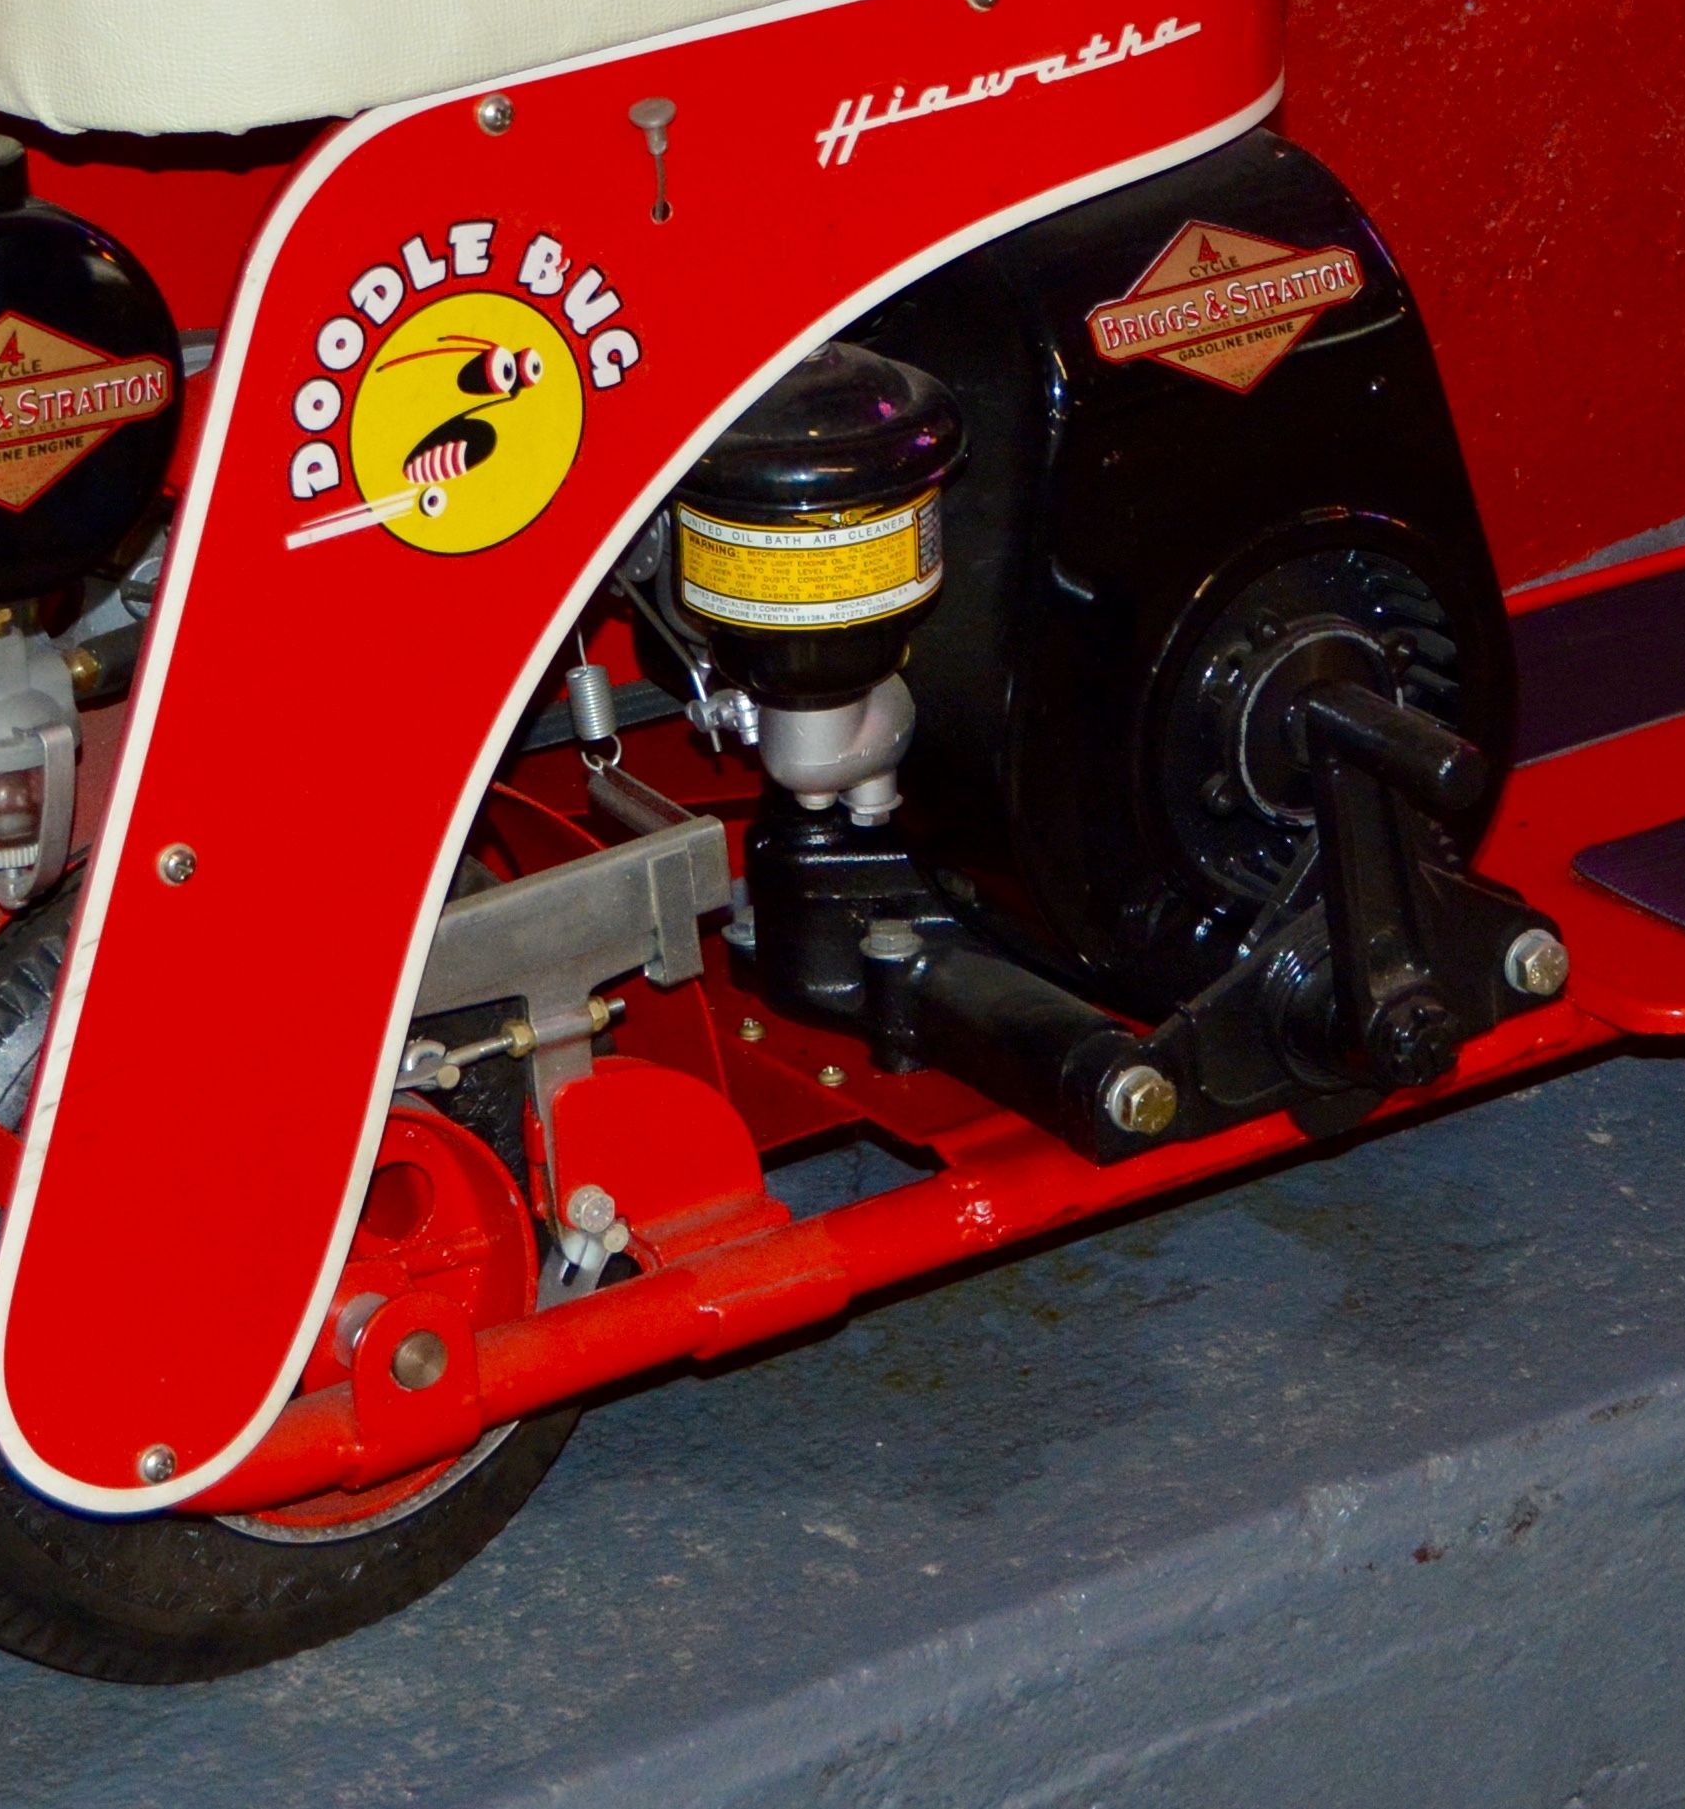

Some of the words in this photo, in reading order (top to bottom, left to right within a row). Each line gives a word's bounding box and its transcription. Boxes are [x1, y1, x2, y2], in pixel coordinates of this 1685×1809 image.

[815, 17, 1202, 170] Hiawatha
[1197, 233, 1221, 262] 4
[1189, 256, 1240, 279] CYCLE
[1099, 301, 1201, 351] BRIGGS
[1204, 289, 1229, 321] &
[1226, 258, 1356, 316] STRATTON
[1178, 335, 1244, 362] GASOLINE
[1246, 321, 1295, 344] ENGINE
[289, 219, 498, 500] DOODLE
[517, 232, 641, 390] BUG
[16, 370, 165, 427] STRATTON
[27, 435, 85, 458] ENGINE
[685, 515, 722, 537] UNITED
[732, 530, 753, 543] OIL
[765, 535, 802, 545] BATH
[813, 533, 837, 545] AIR
[848, 516, 905, 540] CLEANER
[689, 534, 741, 558] WARNING:
